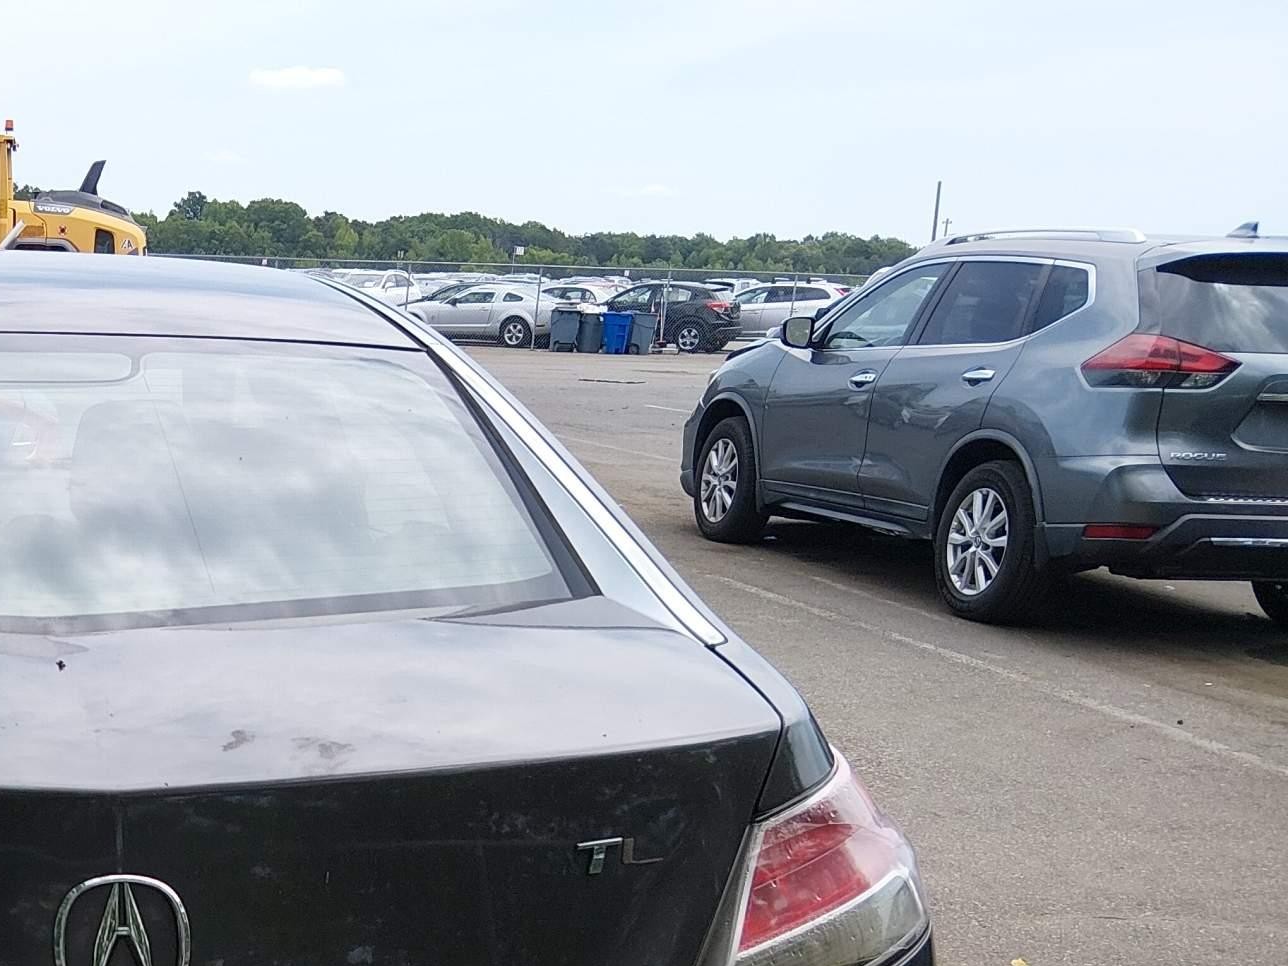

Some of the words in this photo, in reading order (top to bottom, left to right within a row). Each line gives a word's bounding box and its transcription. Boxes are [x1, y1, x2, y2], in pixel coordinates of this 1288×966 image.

[37, 205, 70, 214] VOLVO
[1170, 452, 1227, 461] ROGUE
[576, 837, 664, 874] TL
